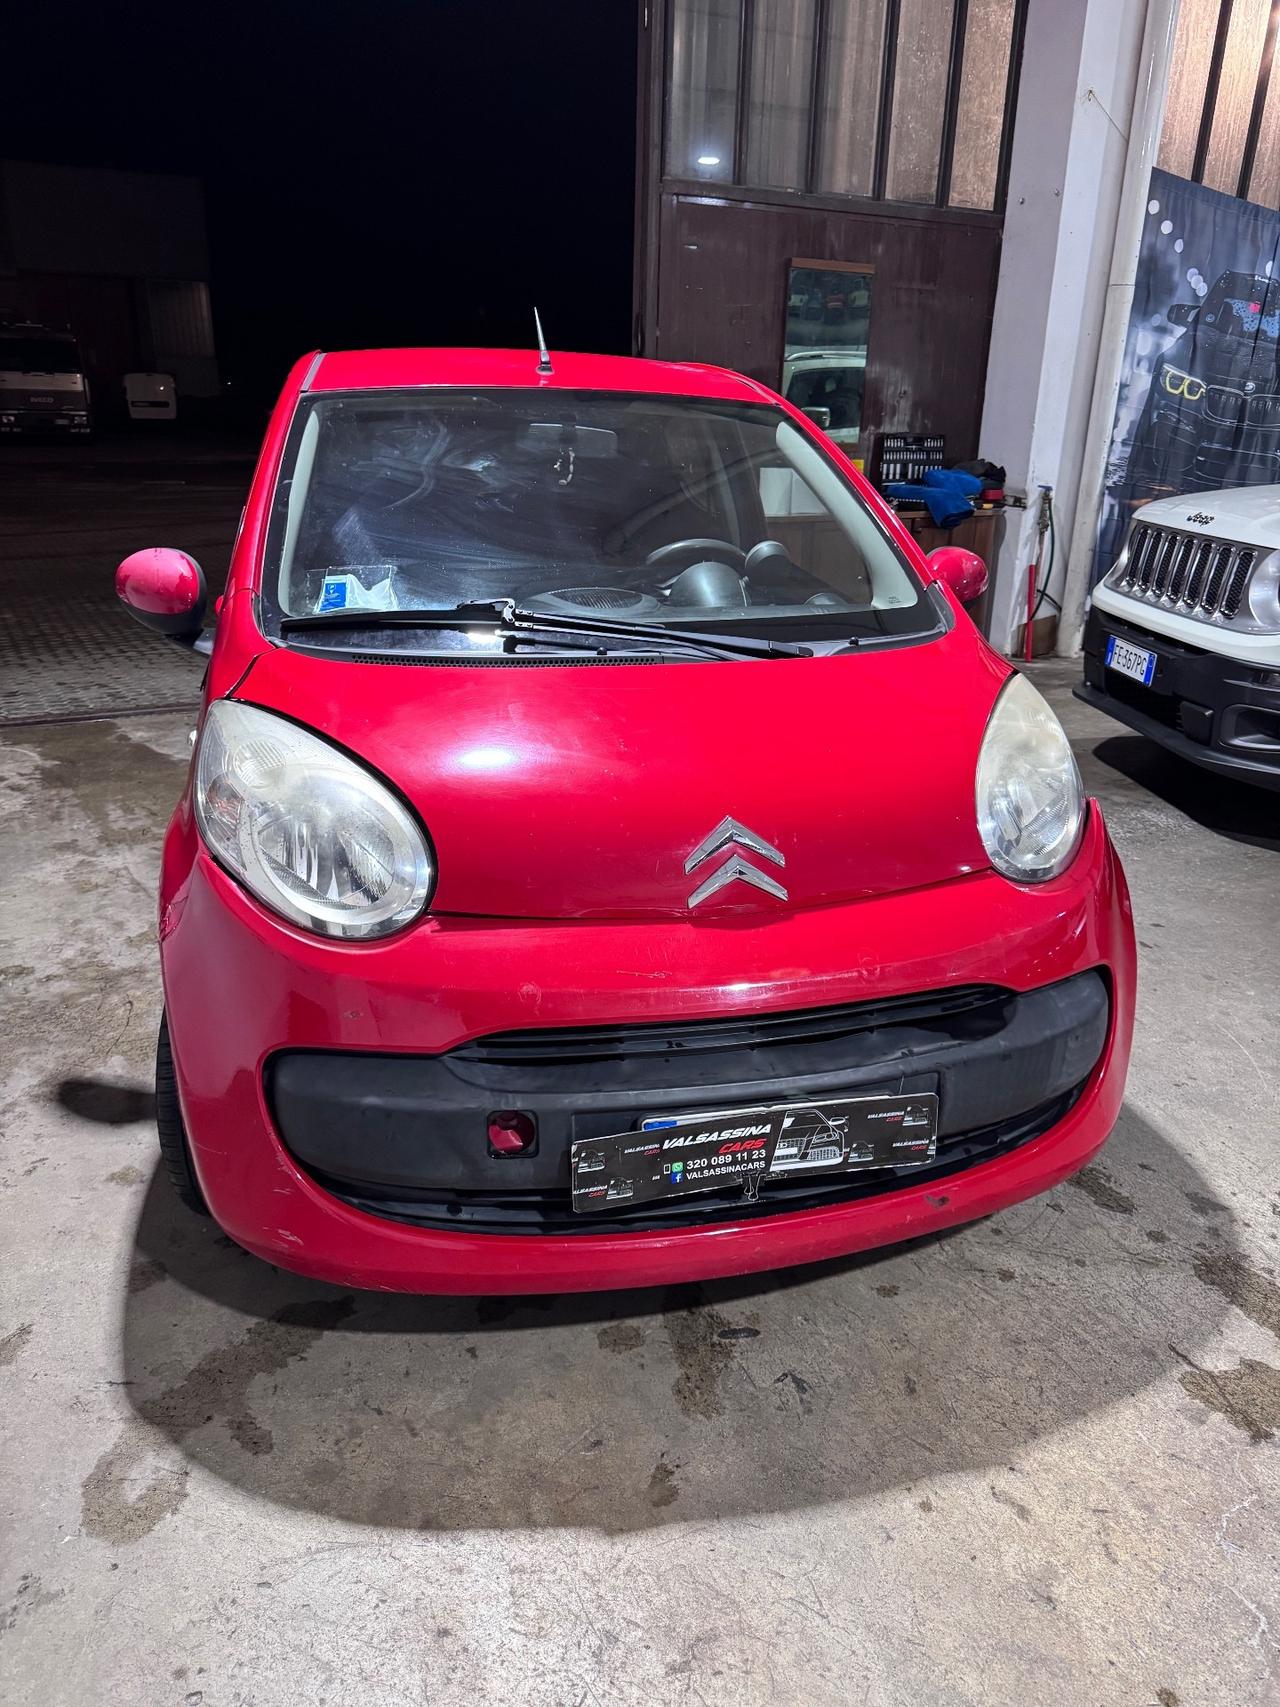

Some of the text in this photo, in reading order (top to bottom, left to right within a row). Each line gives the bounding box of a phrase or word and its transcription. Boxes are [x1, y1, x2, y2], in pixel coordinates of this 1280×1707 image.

[1186, 512, 1214, 526] Jeep
[1112, 644, 1147, 675] FE367PG
[867, 1111, 904, 1119] VALSASSINA
[662, 1124, 772, 1149] VALSASSINA
[624, 1144, 660, 1153] VALSASSIN
[719, 1138, 767, 1154] CARS
[686, 1148, 766, 1170] 320 089 11 23
[685, 1160, 766, 1181] VALSASSINACARS
[572, 1185, 607, 1194] ALSASSINA
